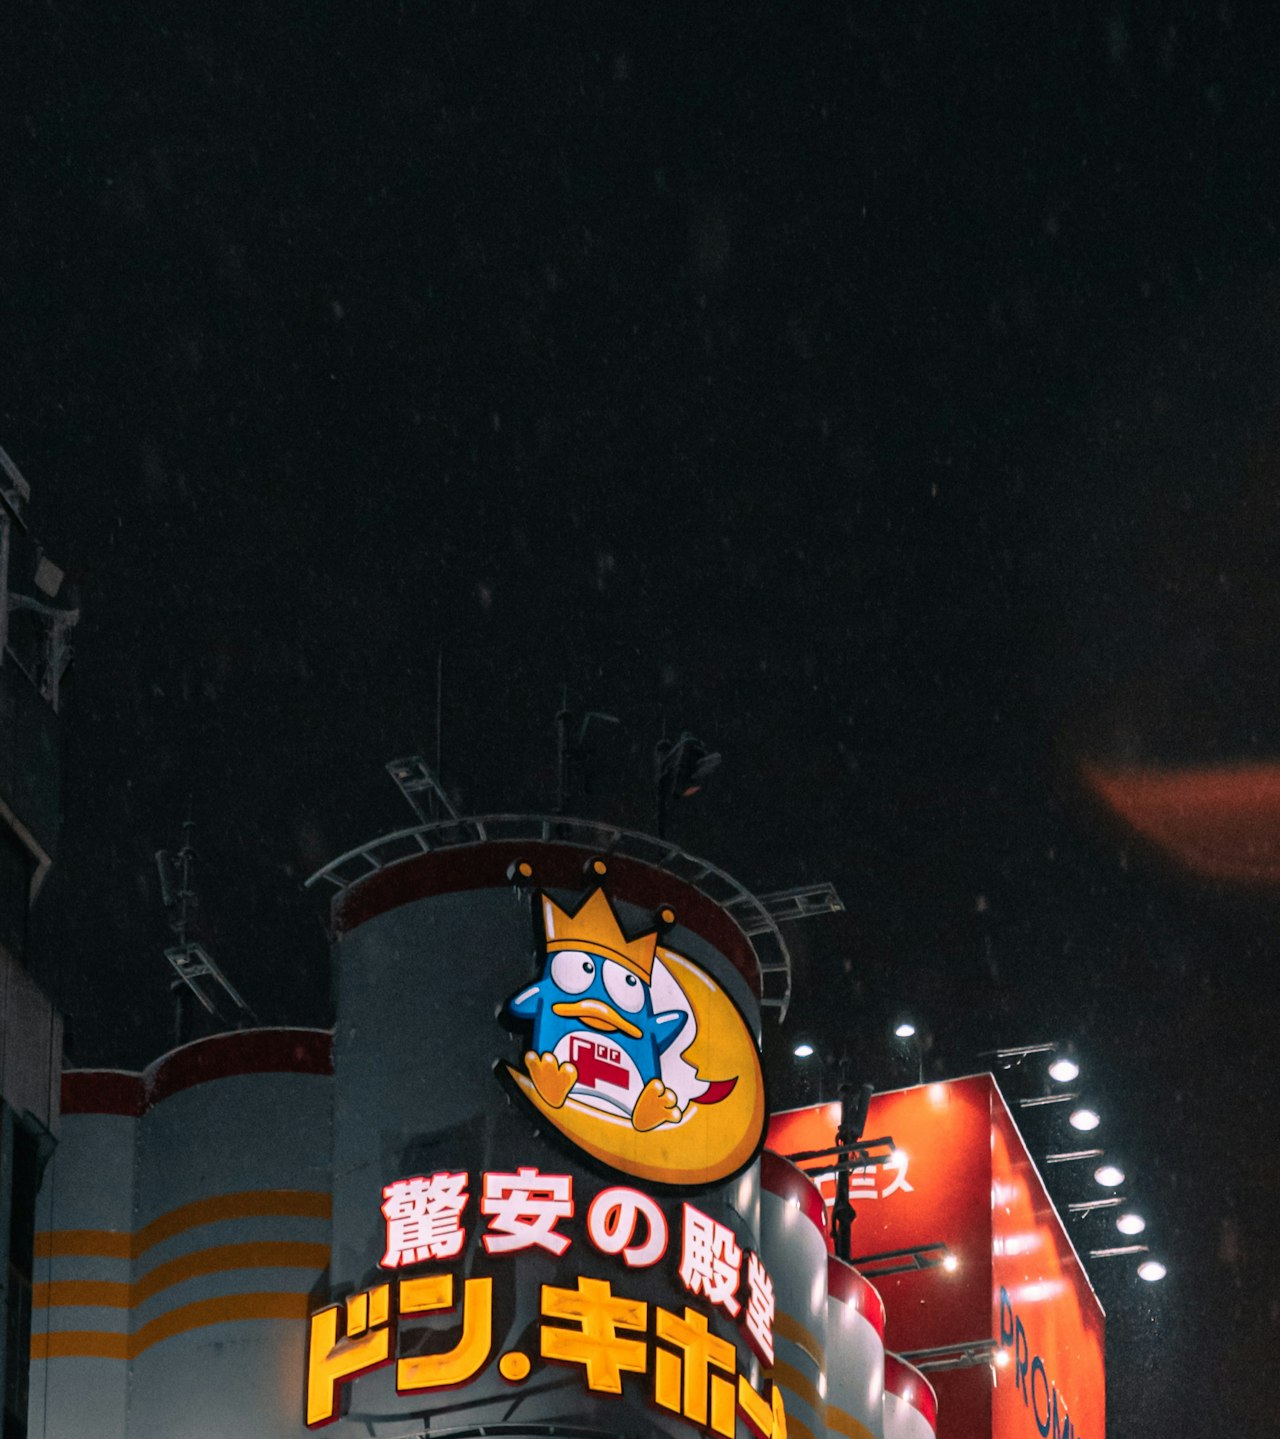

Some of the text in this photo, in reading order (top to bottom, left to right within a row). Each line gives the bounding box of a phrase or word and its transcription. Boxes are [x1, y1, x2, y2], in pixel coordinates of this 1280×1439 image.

[381, 1167, 775, 1367] 驚安の殿堂
